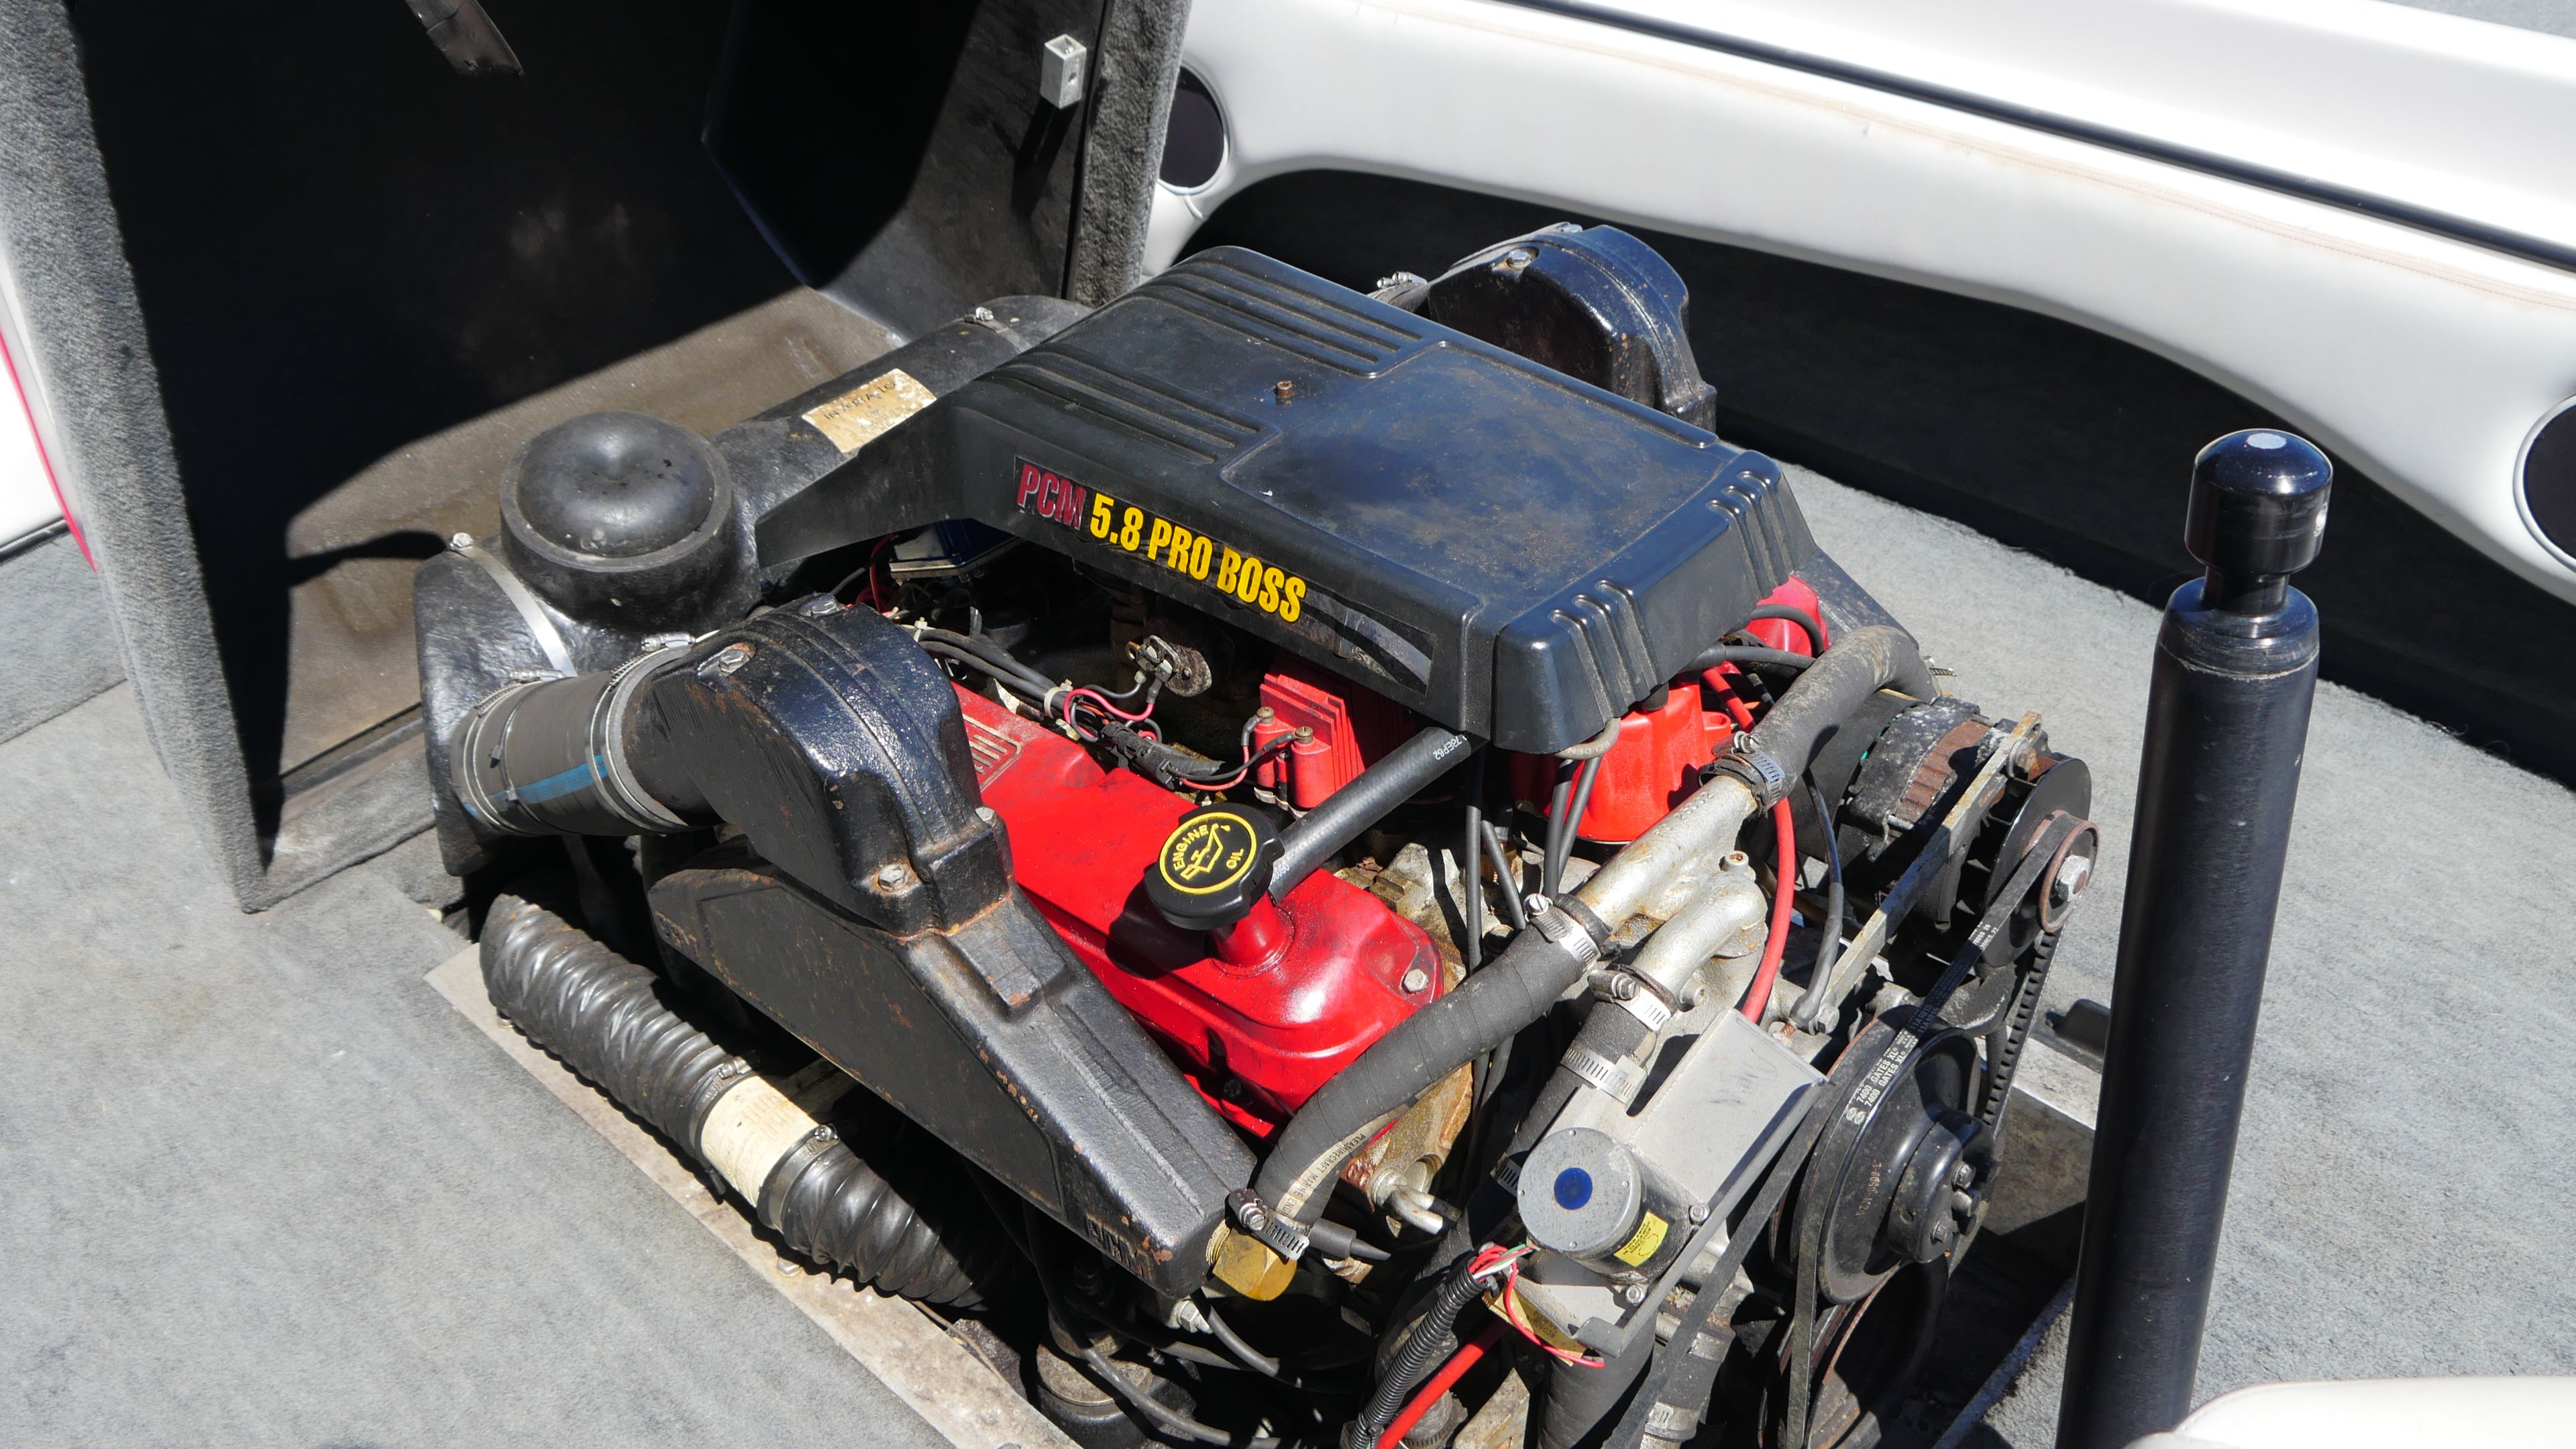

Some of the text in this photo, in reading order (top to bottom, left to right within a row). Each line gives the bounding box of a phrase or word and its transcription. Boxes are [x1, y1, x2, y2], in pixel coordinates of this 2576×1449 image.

[1016, 463, 1306, 623] PCM 5.8 PRO BOSS
[1173, 824, 1210, 871] ENGINE
[1226, 848, 1244, 869] OIL
[1856, 1085, 1872, 1103] 7400
[1870, 1060, 1891, 1083] GATES
[1864, 1088, 1880, 1107] 7400
[1878, 1063, 1899, 1087] GATES
[1319, 1133, 1366, 1173] PLEASURECRAFT
[1293, 1173, 1322, 1198] MARINE
